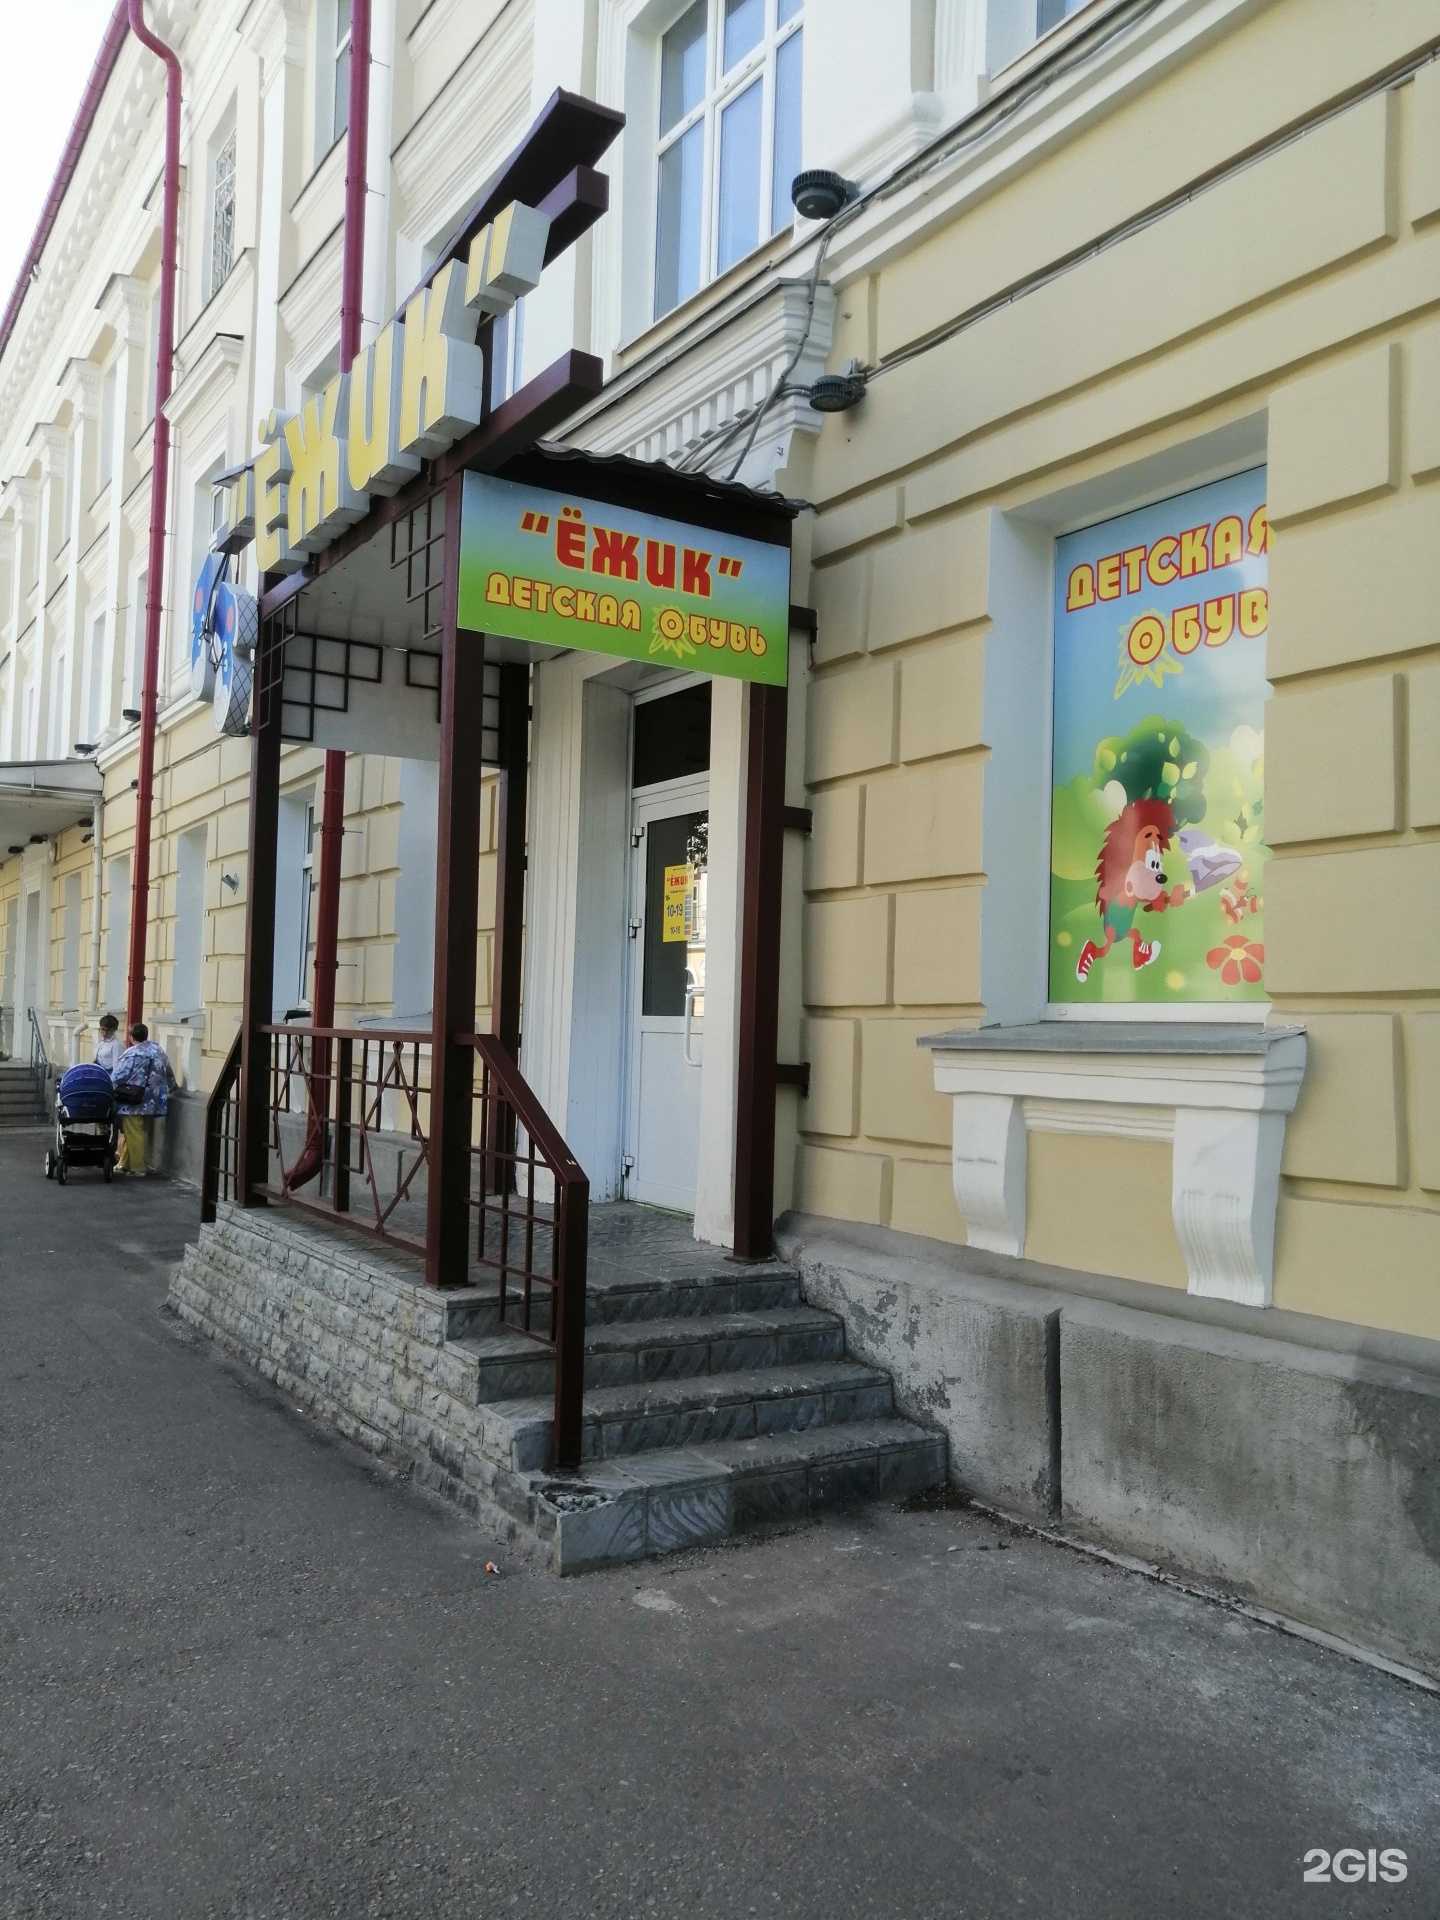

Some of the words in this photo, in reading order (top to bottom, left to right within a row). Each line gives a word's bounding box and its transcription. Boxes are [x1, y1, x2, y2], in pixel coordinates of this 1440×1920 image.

[520, 506, 743, 598] "ЁЖИК"
[485, 571, 642, 632] ДЕТСКАЯ
[658, 607, 768, 656] ОБУВЬ
[1127, 587, 1269, 666] ОБУВ
